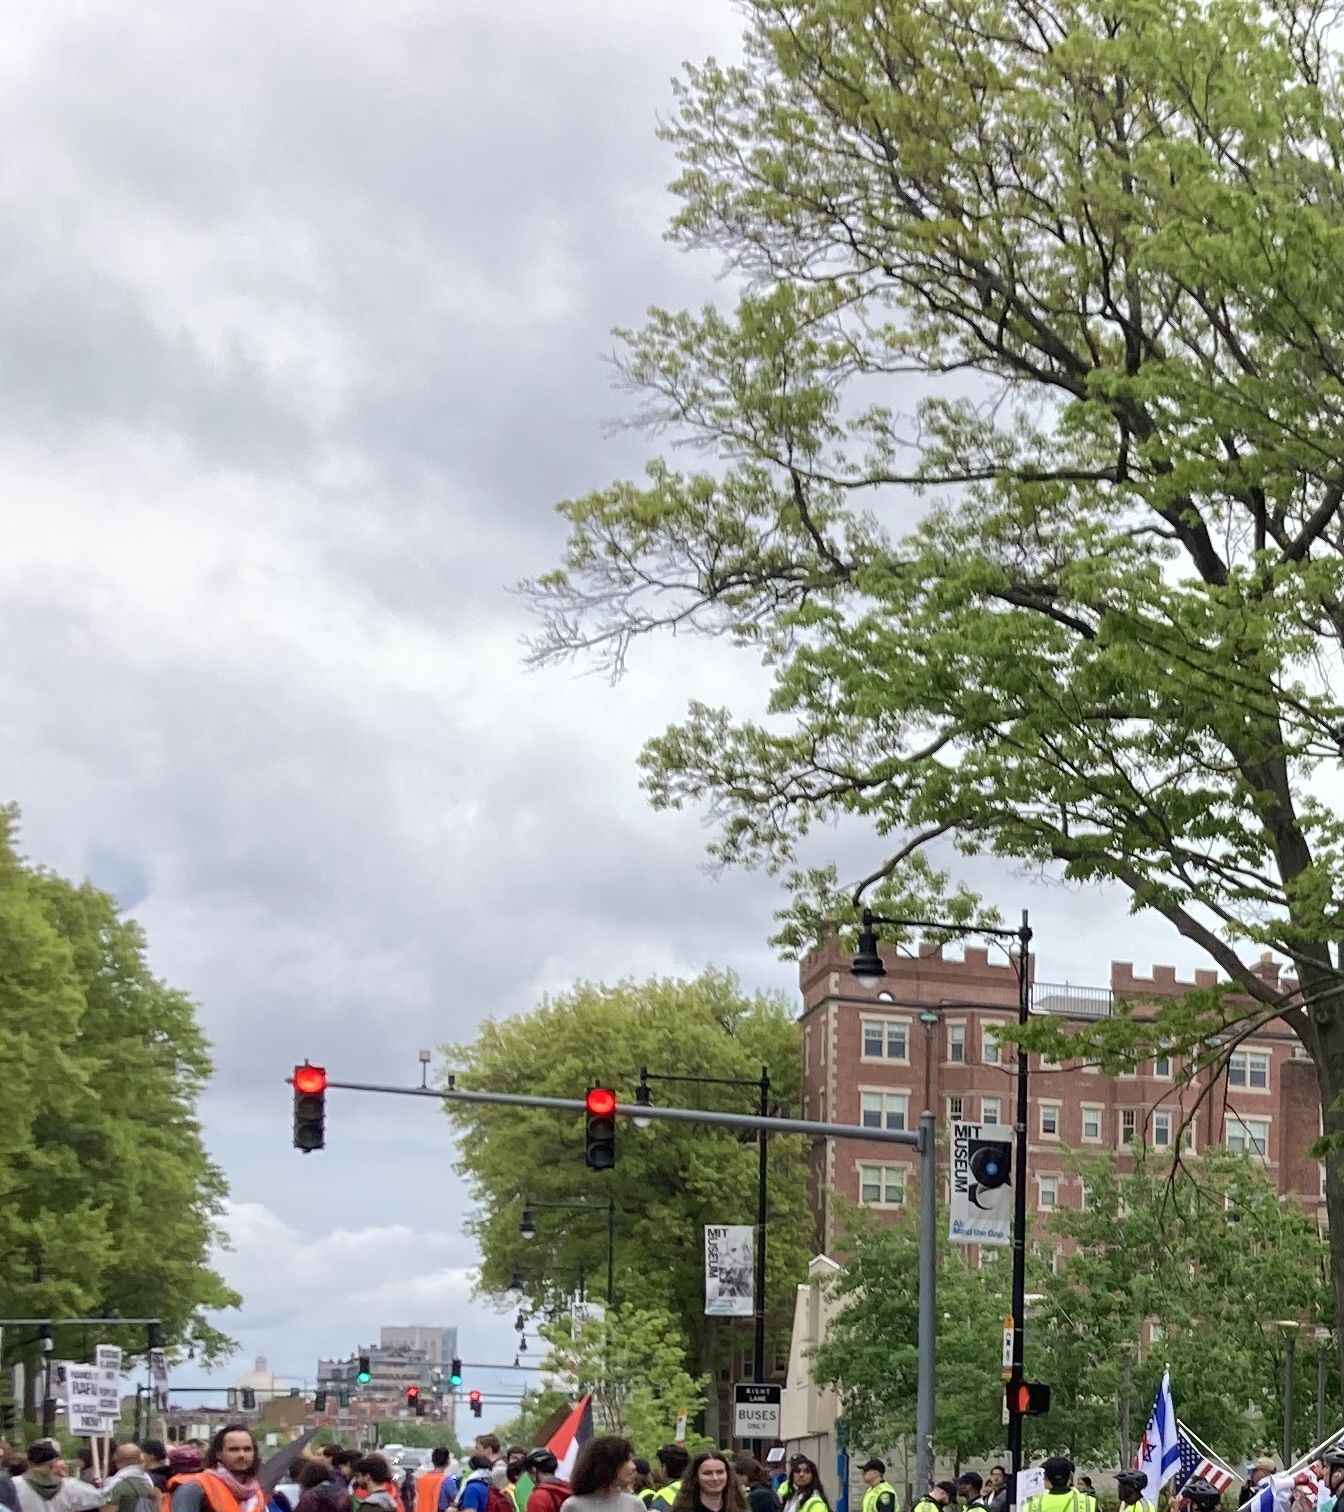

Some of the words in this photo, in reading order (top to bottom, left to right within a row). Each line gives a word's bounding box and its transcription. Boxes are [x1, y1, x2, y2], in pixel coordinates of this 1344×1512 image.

[954, 1124, 982, 1138] MIT
[707, 1228, 728, 1238] MIT
[738, 1409, 776, 1421] BUSES
